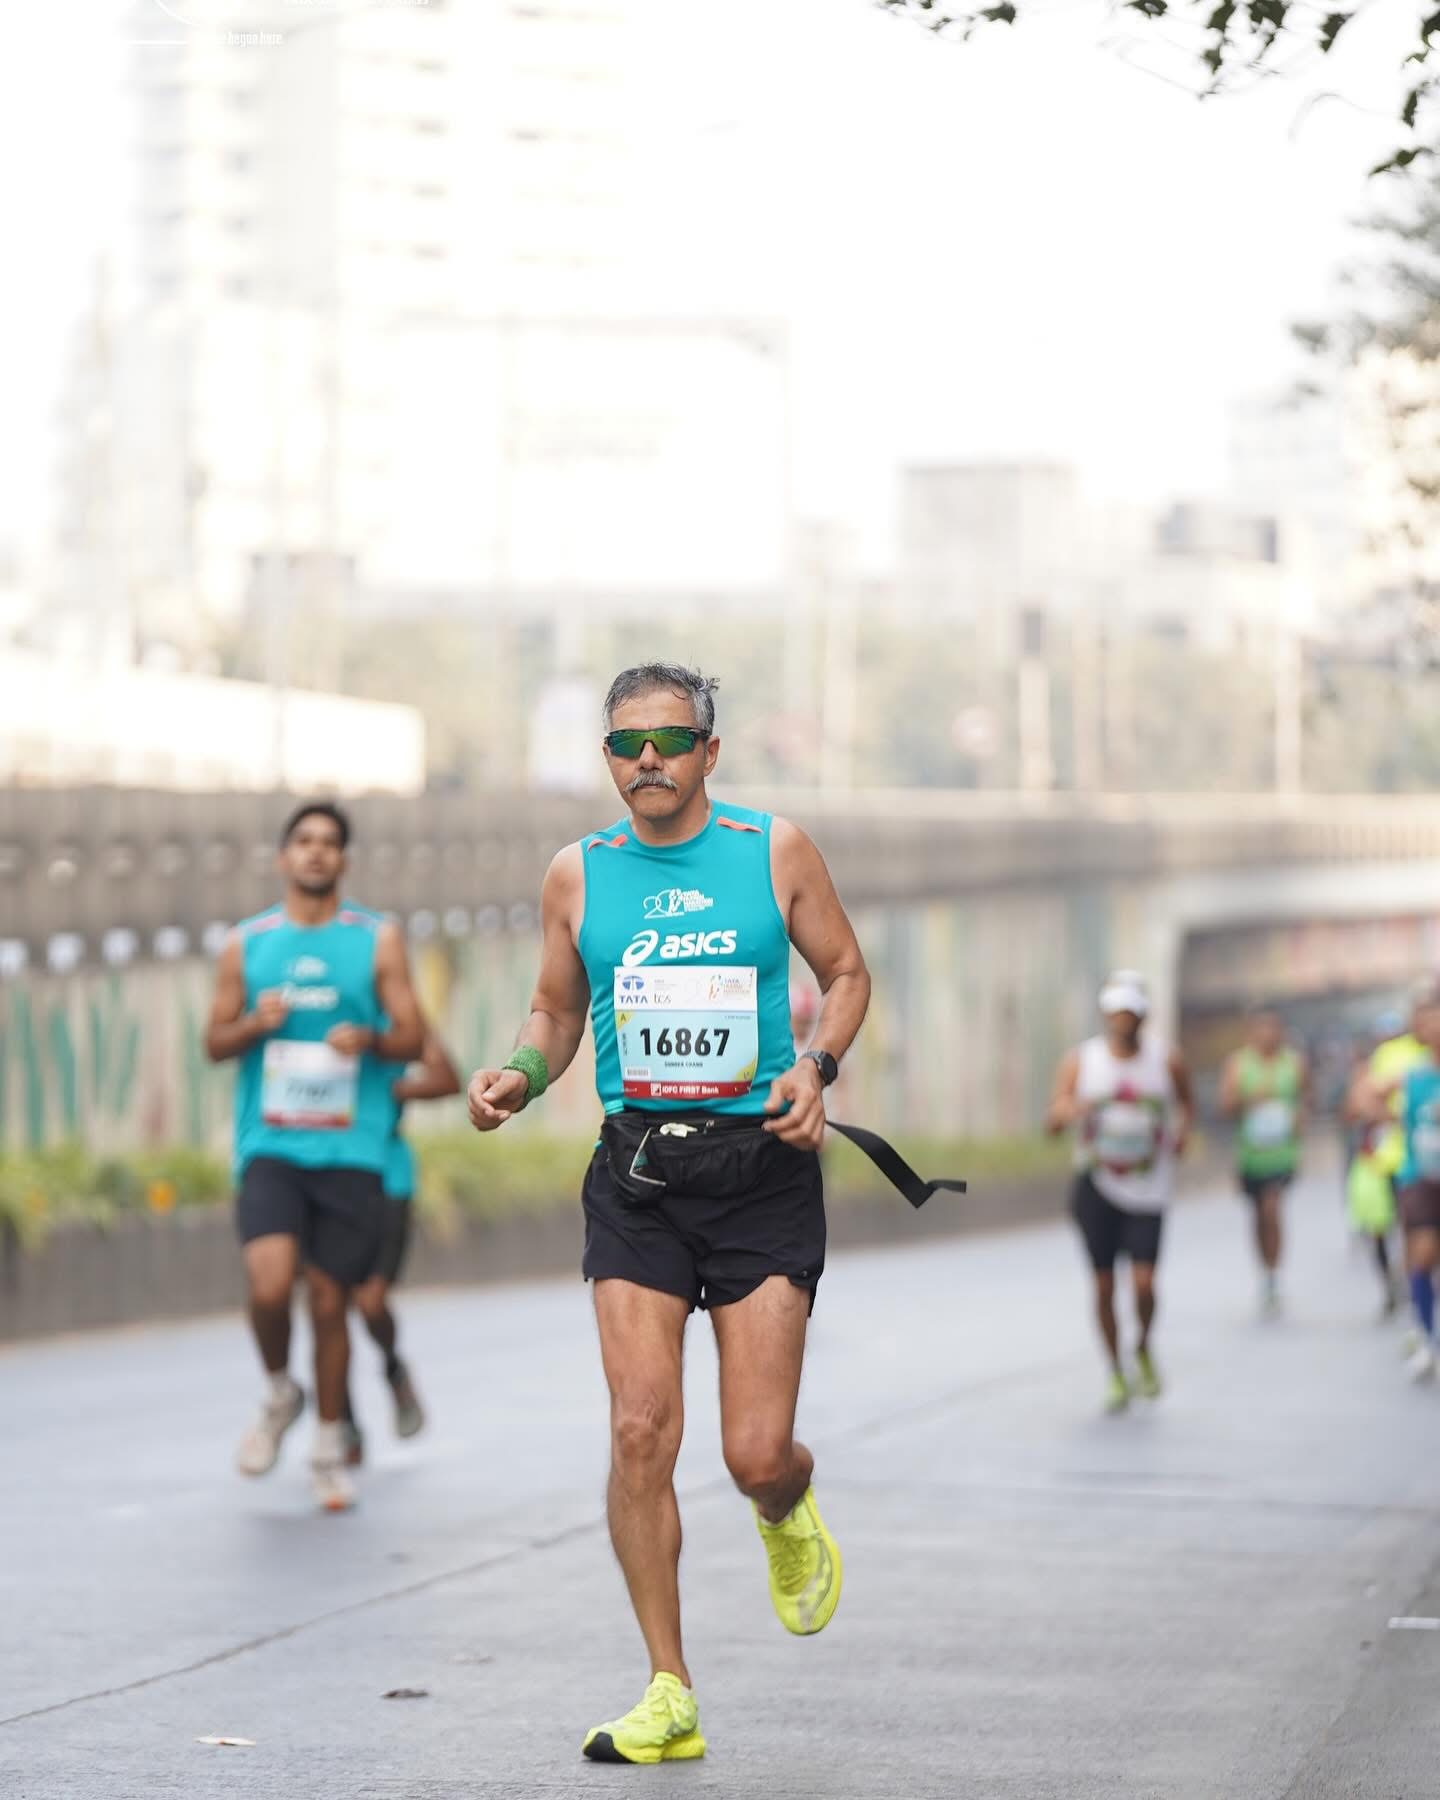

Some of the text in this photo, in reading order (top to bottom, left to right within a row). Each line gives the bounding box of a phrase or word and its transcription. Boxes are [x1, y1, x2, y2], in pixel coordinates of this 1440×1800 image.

[660, 930, 737, 959] asics
[619, 995, 648, 1004] TATA
[640, 1028, 730, 1056] 16867
[679, 1085, 700, 1094] FIRST
[701, 1085, 719, 1094] Bank
